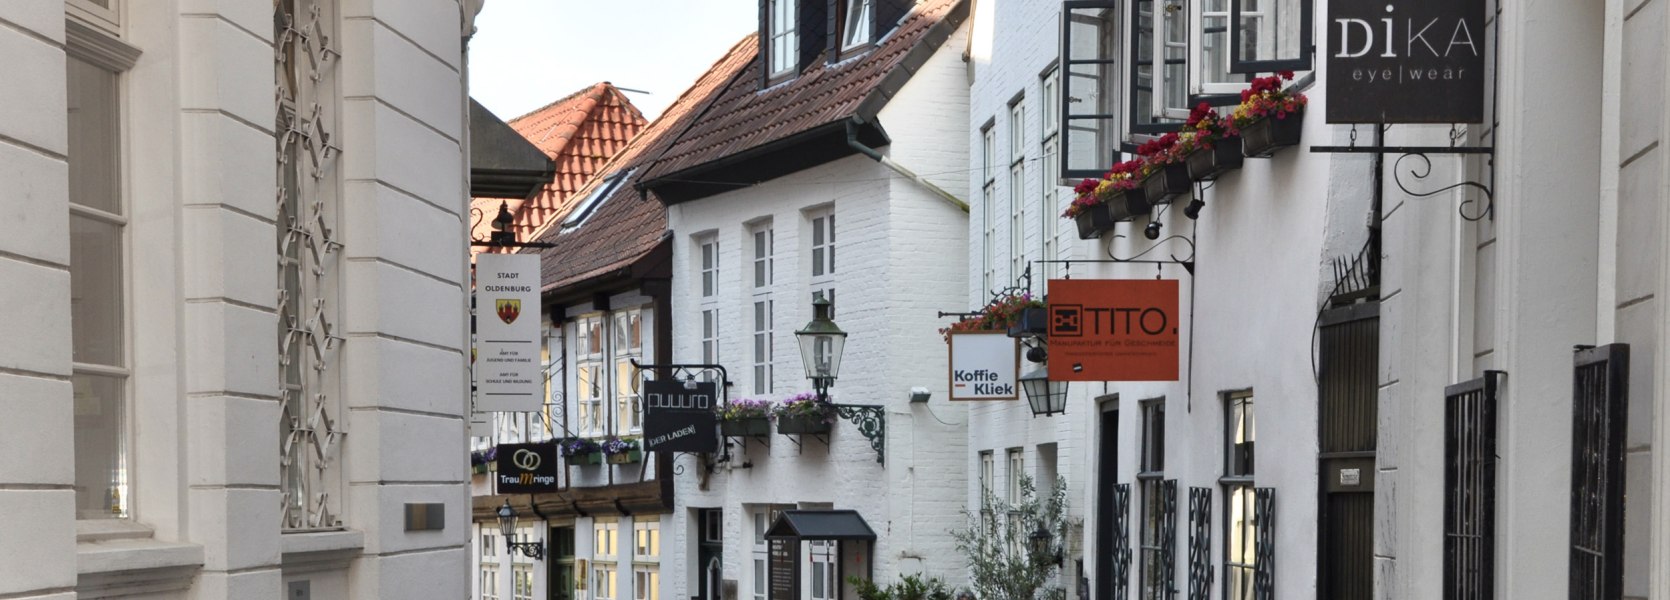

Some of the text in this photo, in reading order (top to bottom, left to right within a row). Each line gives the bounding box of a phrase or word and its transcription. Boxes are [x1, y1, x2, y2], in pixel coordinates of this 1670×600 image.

[954, 369, 998, 382] Koffie
[974, 383, 1013, 395] Kliek
[648, 393, 709, 415] puuuro
